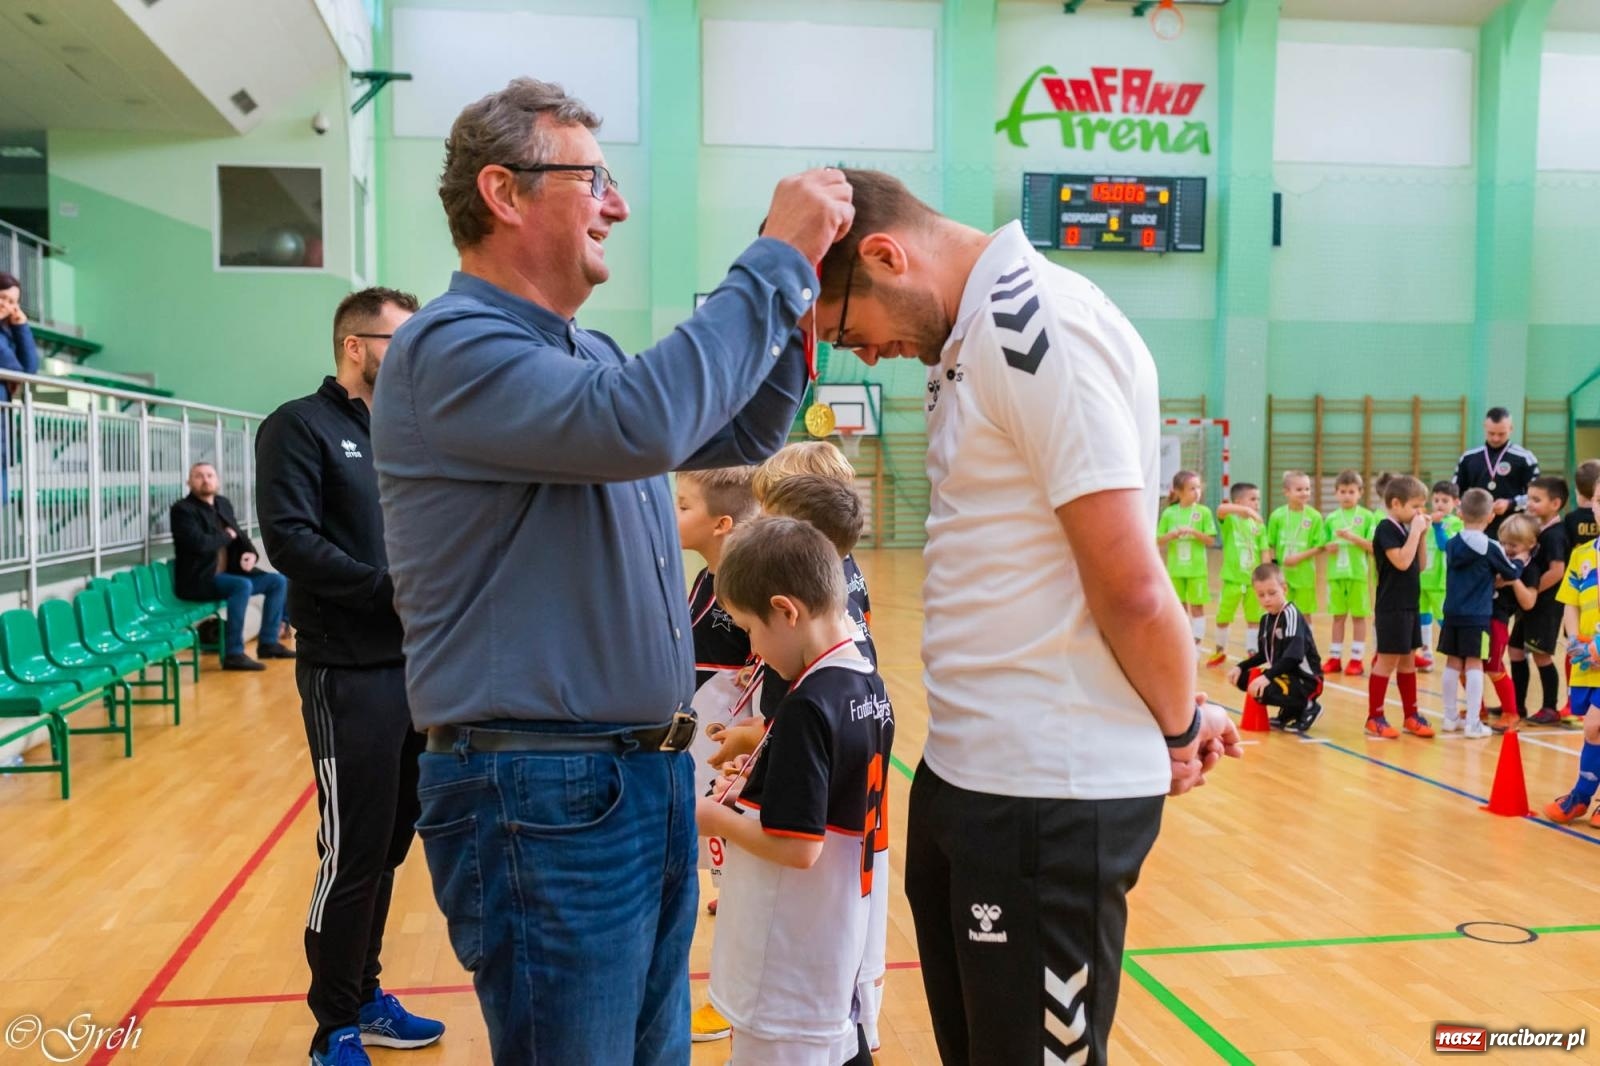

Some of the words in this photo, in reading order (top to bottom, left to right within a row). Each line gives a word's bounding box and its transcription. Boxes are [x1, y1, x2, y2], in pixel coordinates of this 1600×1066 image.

[995, 65, 1211, 155] Arena
[1041, 66, 1205, 116] RAFAKO
[969, 928, 1007, 943] hummel
